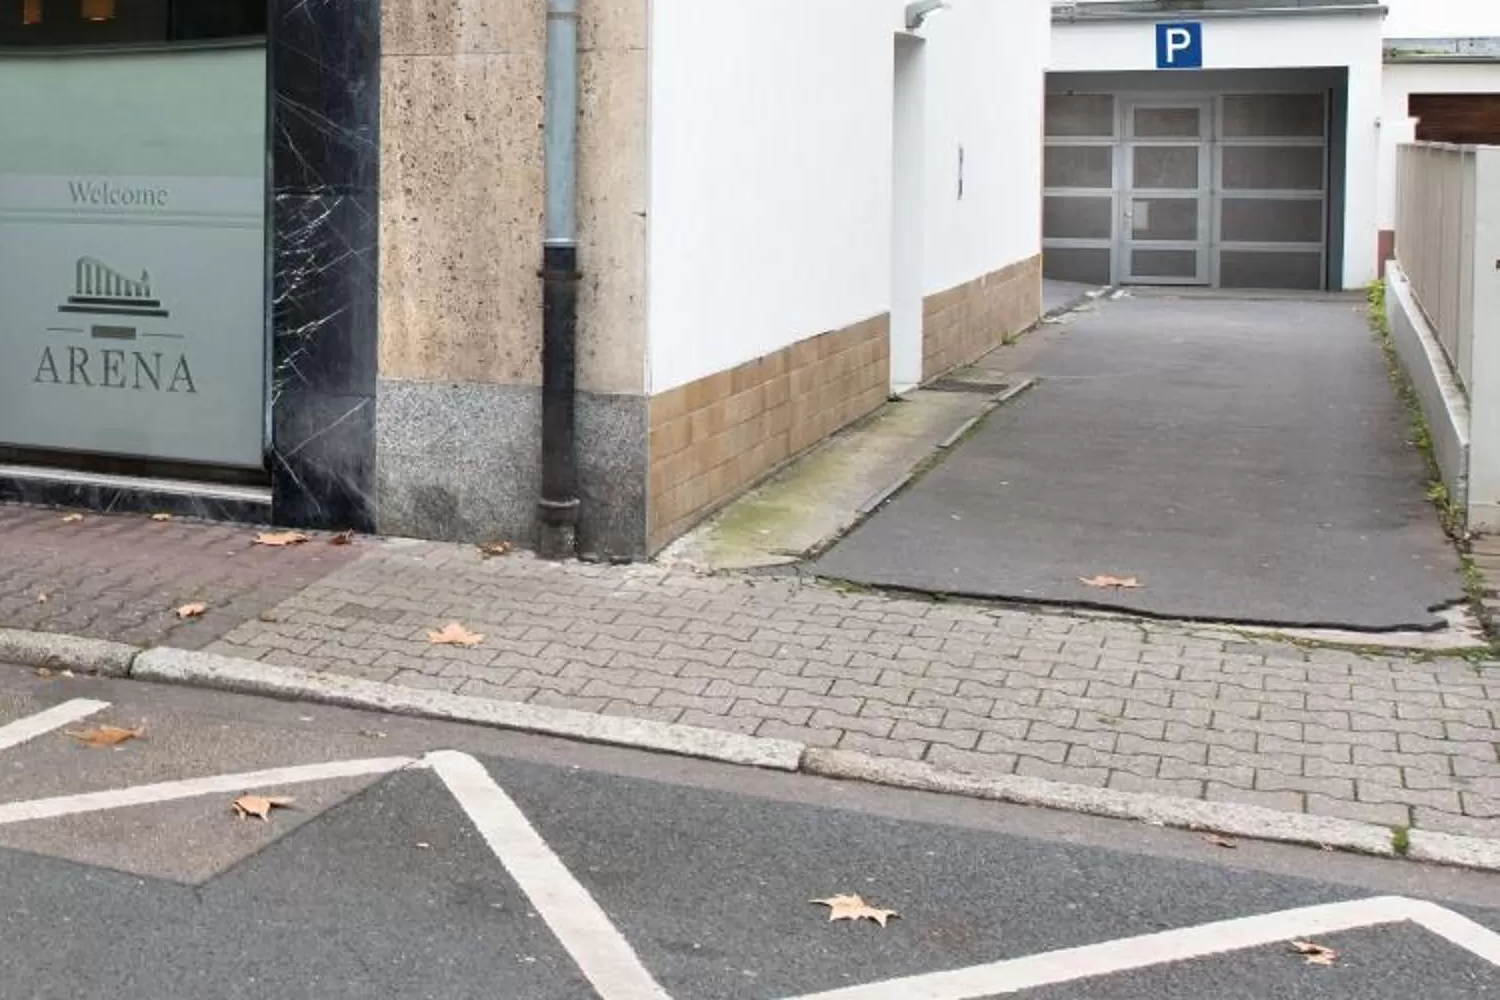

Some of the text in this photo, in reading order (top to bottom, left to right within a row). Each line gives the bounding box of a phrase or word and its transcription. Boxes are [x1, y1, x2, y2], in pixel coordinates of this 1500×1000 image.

[1167, 29, 1191, 62] P
[68, 181, 168, 206] Welcome
[32, 346, 197, 393] ARENA
